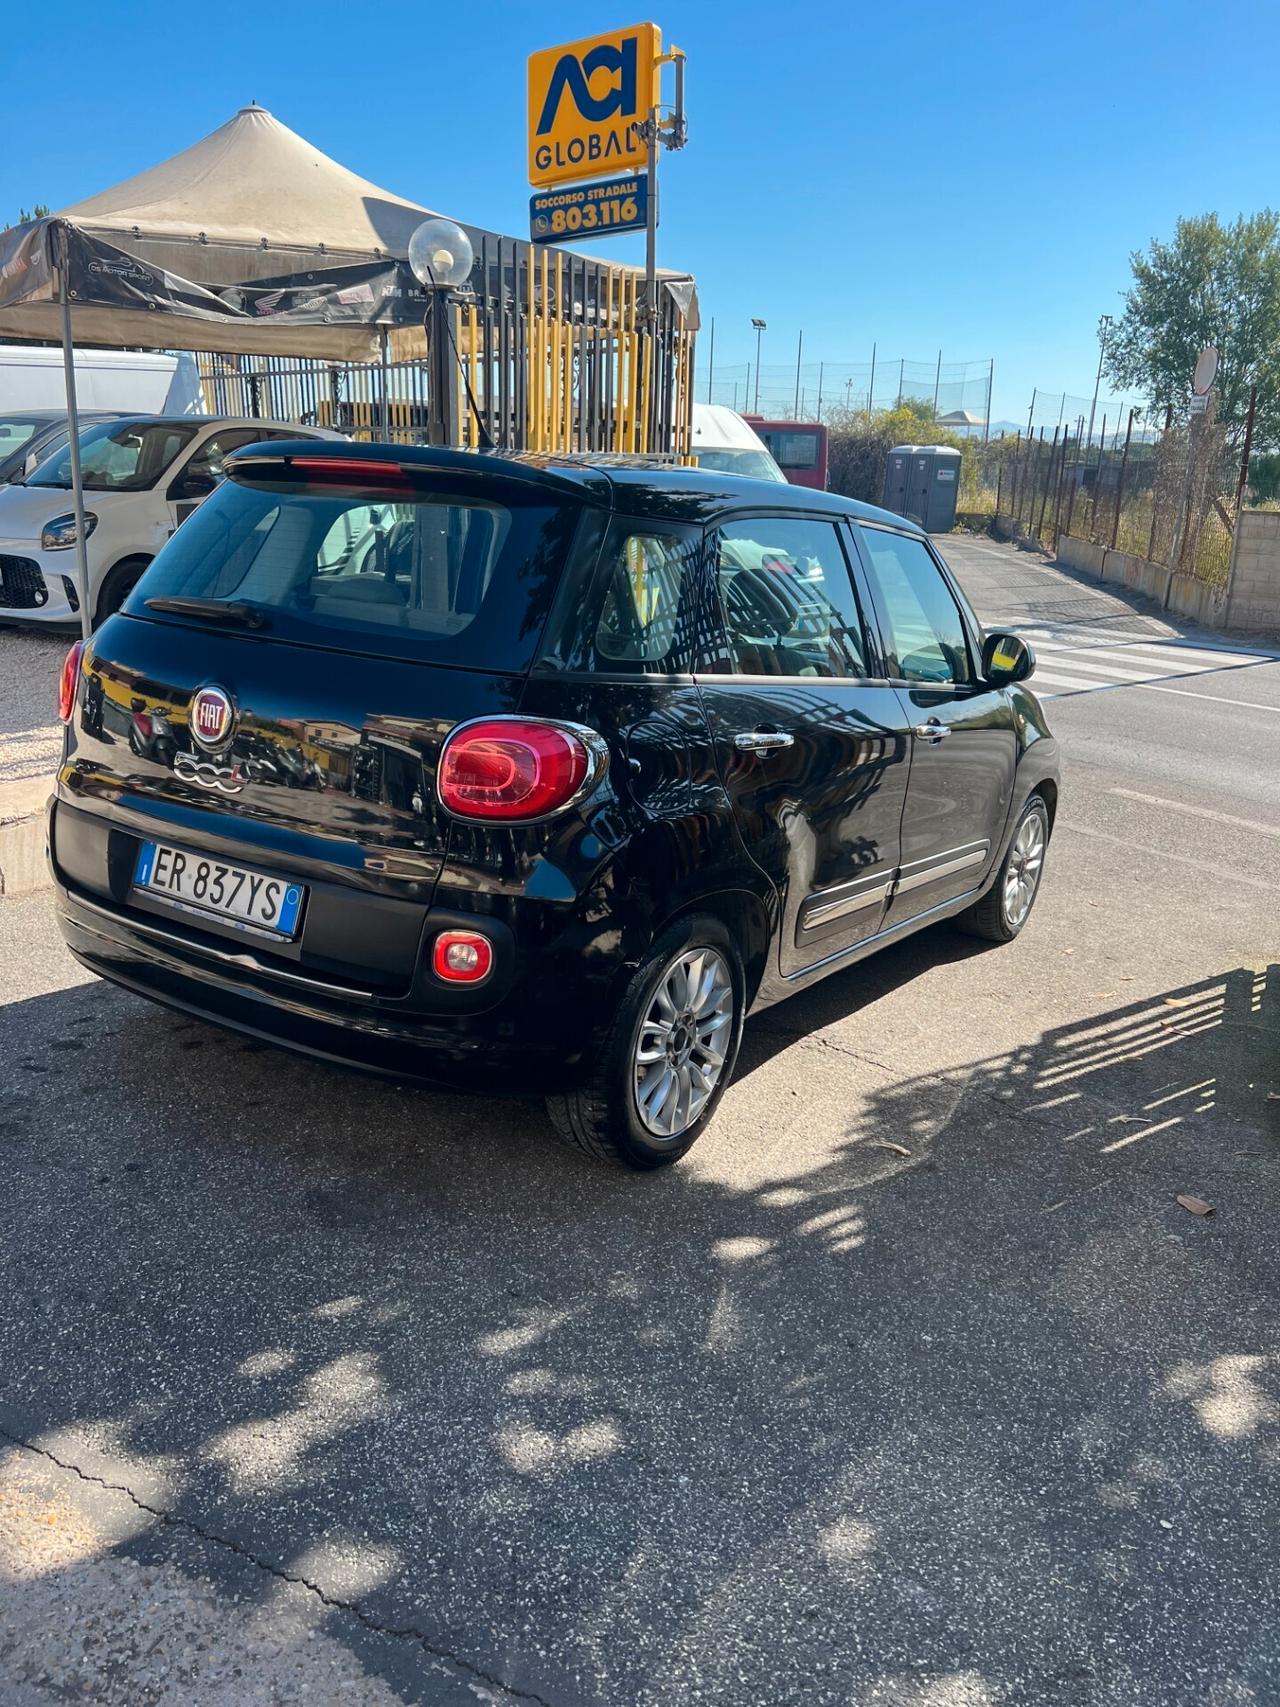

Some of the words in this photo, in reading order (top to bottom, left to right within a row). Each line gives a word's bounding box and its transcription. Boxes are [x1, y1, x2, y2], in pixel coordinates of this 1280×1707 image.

[535, 36, 638, 136] ACI
[535, 126, 637, 170] GLOBAL
[535, 191, 585, 210] SOCCORSO
[587, 181, 638, 201] STRADALE
[551, 196, 638, 233] 803.116
[199, 701, 224, 730] FIAT
[173, 750, 250, 794] 500L
[153, 847, 187, 892] ER
[192, 861, 281, 921] 837YS
